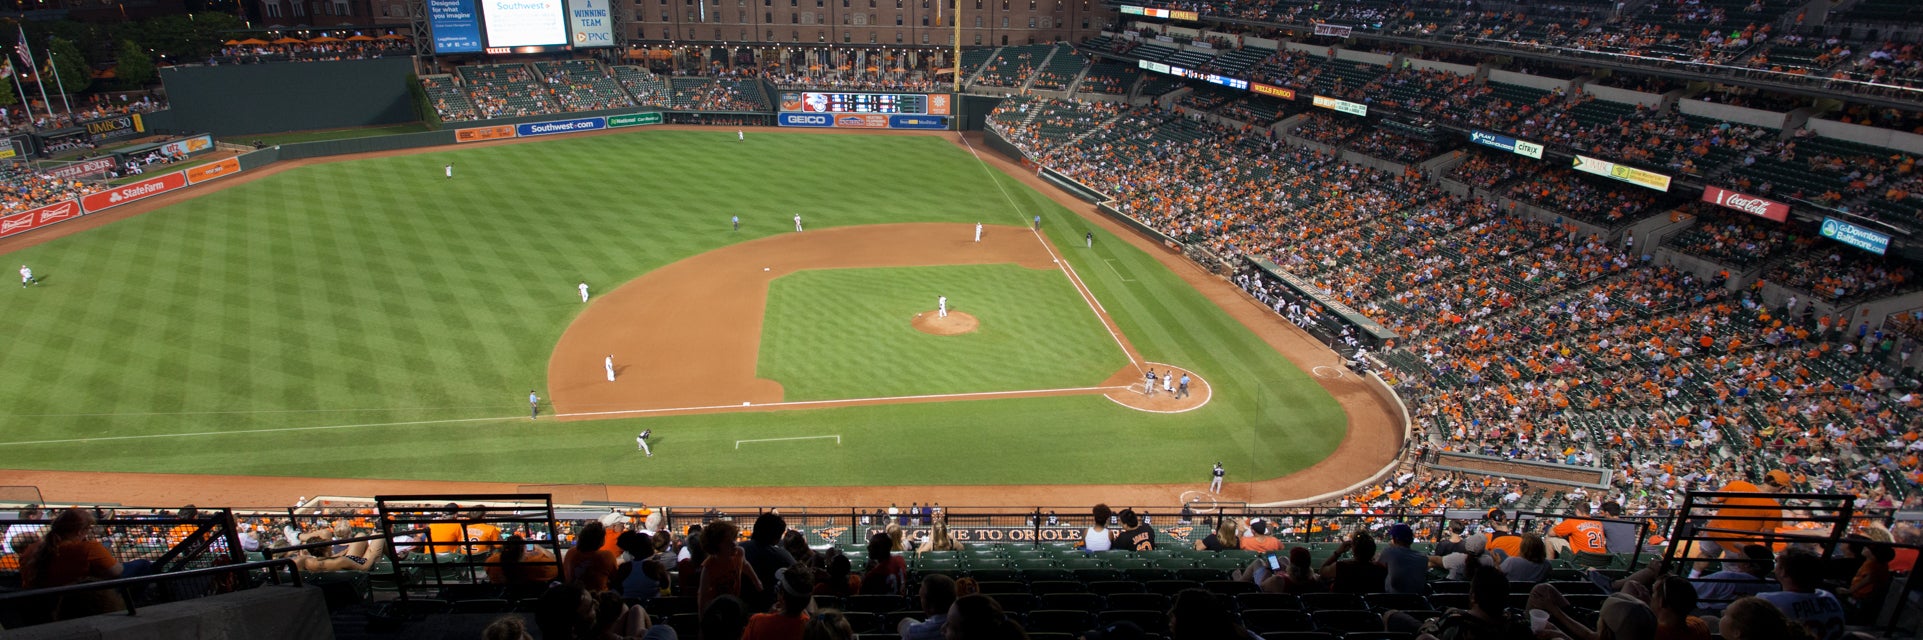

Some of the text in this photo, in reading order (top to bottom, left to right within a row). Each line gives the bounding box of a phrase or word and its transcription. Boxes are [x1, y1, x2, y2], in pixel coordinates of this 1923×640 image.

[497, 1, 544, 10] Southwest
[586, 0, 592, 8] A
[574, 9, 606, 17] WINNING
[581, 19, 602, 27] TEAM
[588, 32, 609, 41] PNC
[1254, 84, 1291, 98] WELLS FARGO
[788, 115, 826, 124] GEICO
[1478, 132, 1491, 140] PLAN
[54, 167, 82, 178] PIZZA
[1835, 232, 1885, 255] Baltimore.com
[975, 529, 1003, 540] TO
[1008, 529, 1083, 541] ORIOLE
[1132, 532, 1149, 544] JONES
[1587, 530, 1603, 549] 21
